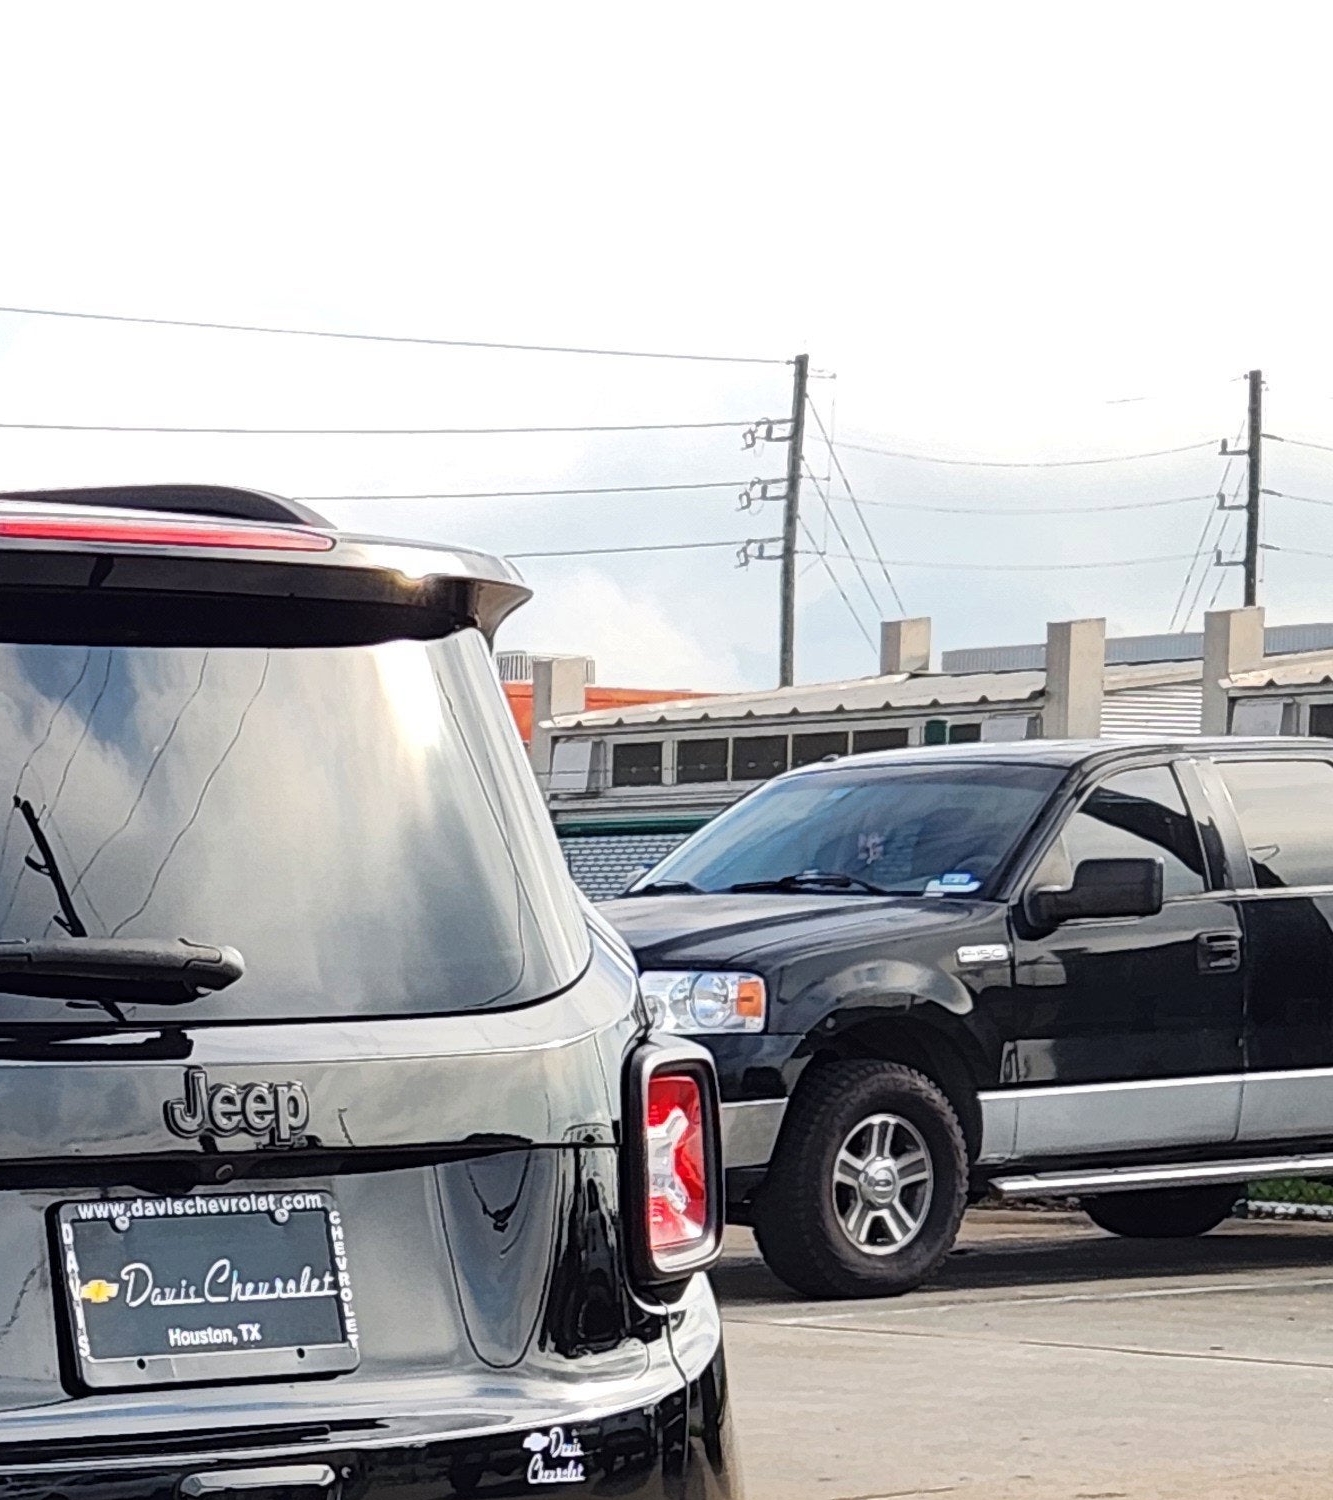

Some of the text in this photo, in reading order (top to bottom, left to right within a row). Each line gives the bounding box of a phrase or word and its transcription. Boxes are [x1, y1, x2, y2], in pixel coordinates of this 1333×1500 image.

[163, 1069, 310, 1146] Jeep
[77, 1193, 323, 1219] www.davischevrolet.com
[61, 1222, 90, 1358] DAVIS
[120, 1259, 338, 1307] Davis Chevrolet
[328, 1210, 360, 1349] CHEVROLET
[168, 1323, 262, 1348] Houston, TX
